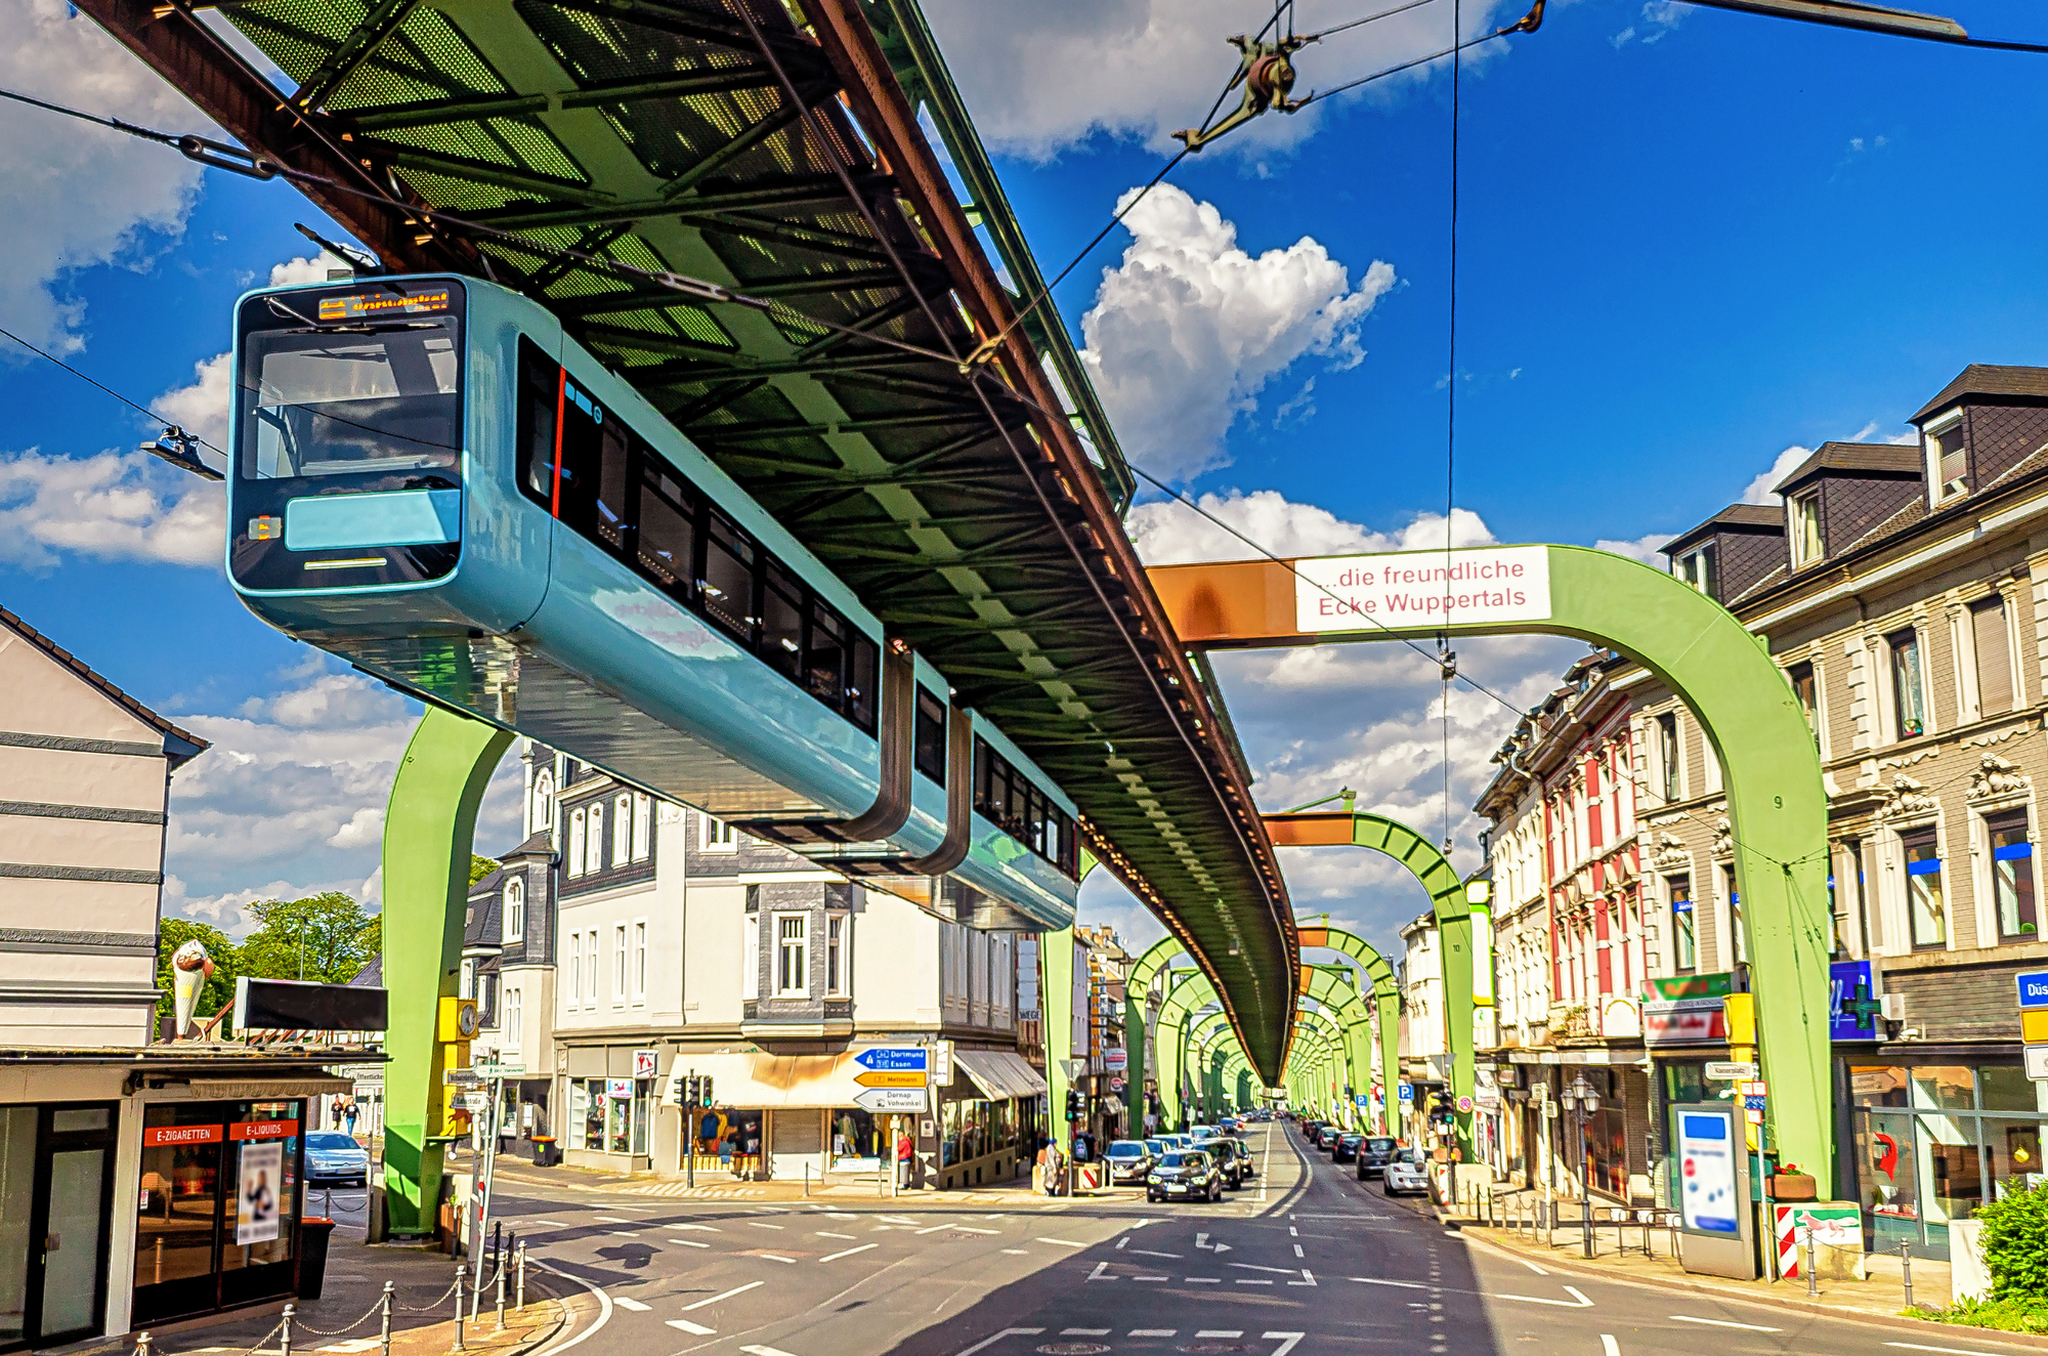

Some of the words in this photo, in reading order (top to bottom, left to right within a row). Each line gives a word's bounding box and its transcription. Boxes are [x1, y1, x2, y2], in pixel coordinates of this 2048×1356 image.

[1317, 568, 1375, 589] ...die
[1383, 560, 1525, 585] freundliche
[1319, 596, 1377, 616] Ecke
[1386, 588, 1526, 616] Wuppertals
[1773, 795, 1782, 810] 9
[1452, 944, 1460, 953] 10
[2027, 983, 2048, 997] Düs
[1019, 1010, 1040, 1020] WEGE
[887, 1091, 911, 1100] Dornap
[1401, 1086, 1411, 1098] P
[156, 1128, 211, 1142] E-ZIGARETTEN
[246, 1124, 282, 1136] E-LIQUIDS
